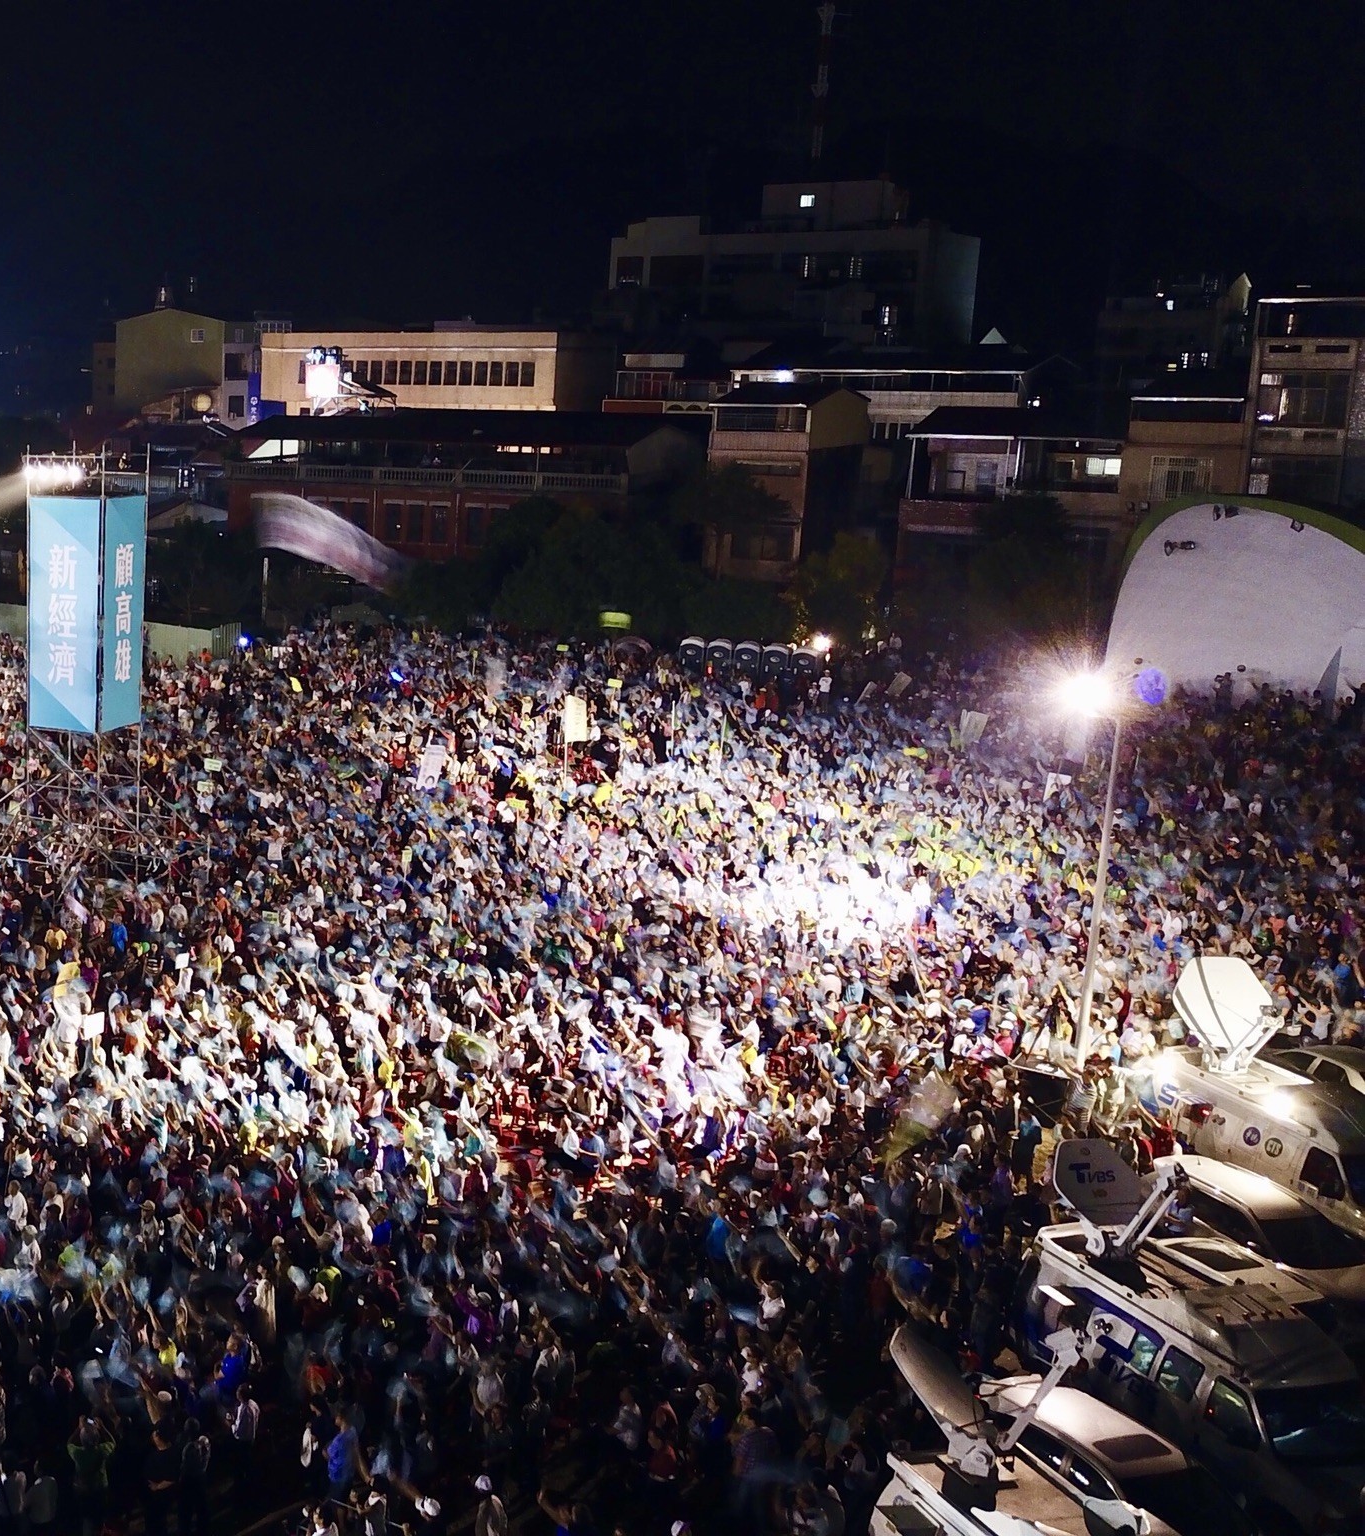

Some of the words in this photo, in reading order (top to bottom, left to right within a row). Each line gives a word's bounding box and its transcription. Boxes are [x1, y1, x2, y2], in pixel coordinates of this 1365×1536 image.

[47, 543, 77, 687] 新經濟
[114, 542, 134, 683] 顧高雄
[1068, 1162, 1116, 1184] TVBS
